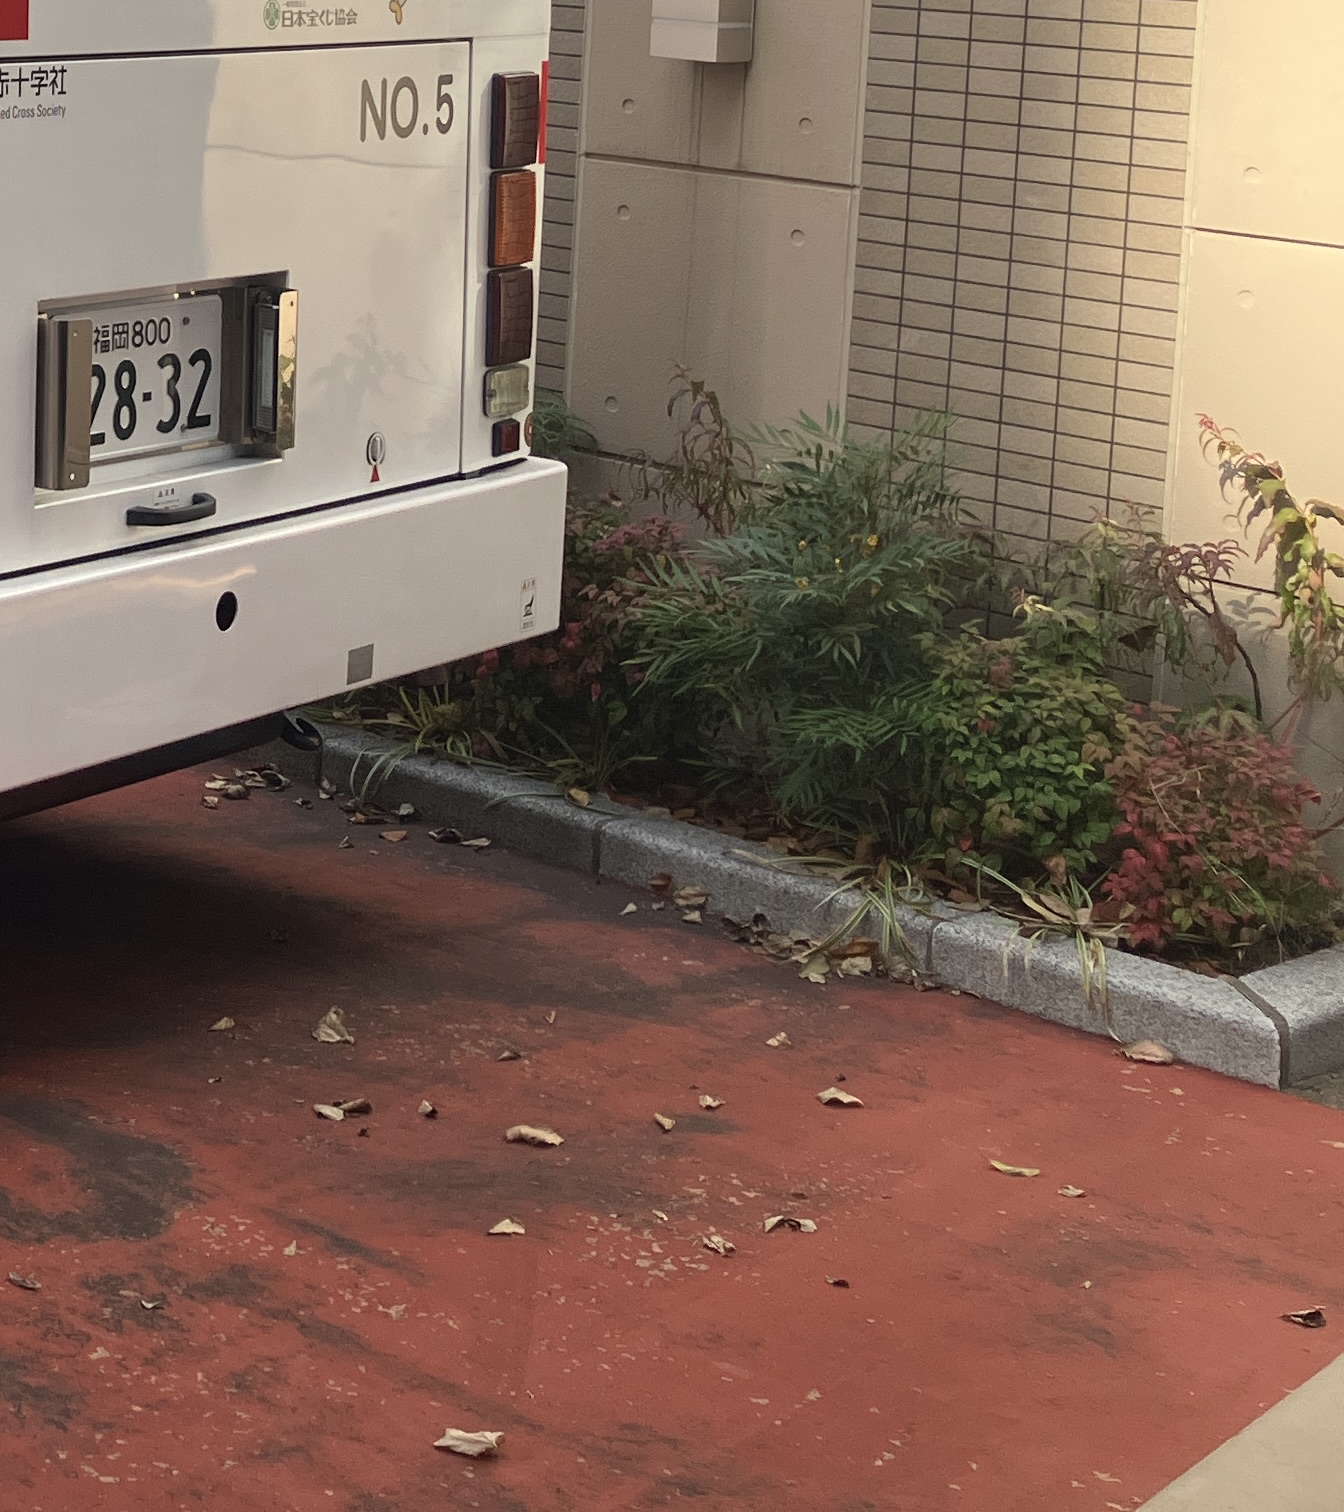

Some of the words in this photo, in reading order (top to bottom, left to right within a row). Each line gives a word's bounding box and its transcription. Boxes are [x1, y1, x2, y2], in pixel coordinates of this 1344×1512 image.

[281, 7, 358, 28] 日本宝くじ協会
[12, 105, 35, 120] Cross
[36, 103, 67, 119] Society
[359, 73, 454, 144] NO.5
